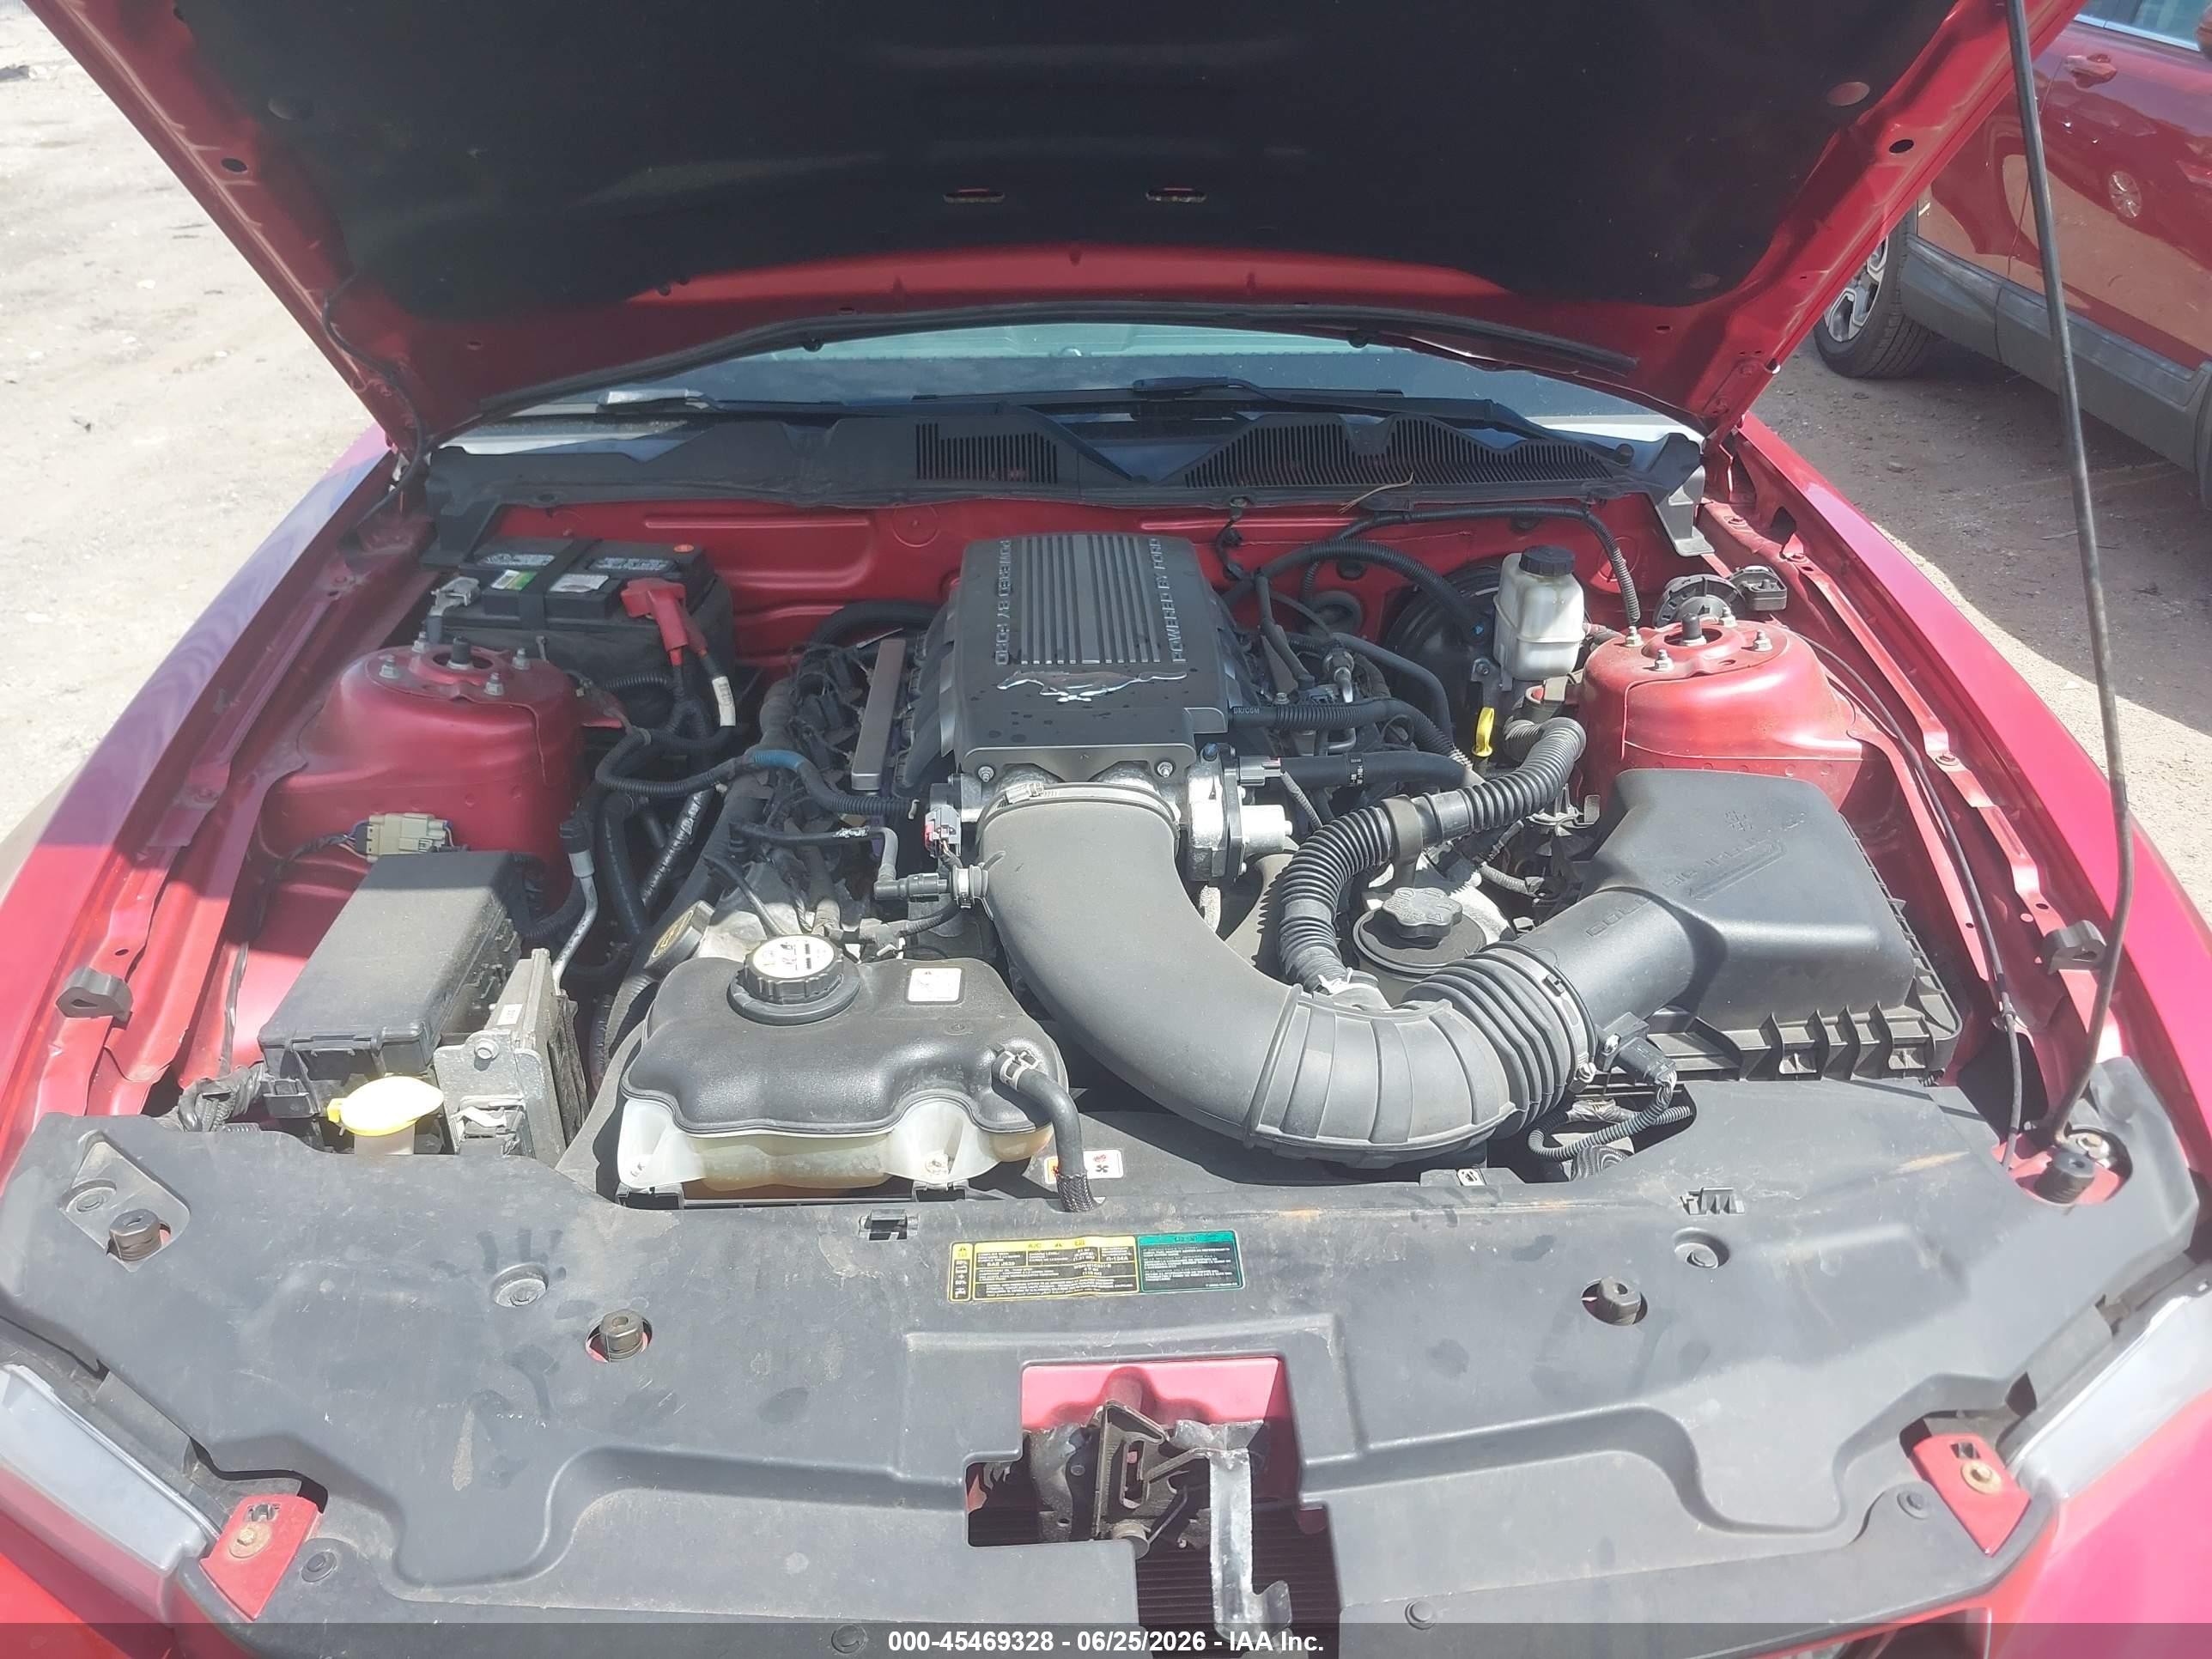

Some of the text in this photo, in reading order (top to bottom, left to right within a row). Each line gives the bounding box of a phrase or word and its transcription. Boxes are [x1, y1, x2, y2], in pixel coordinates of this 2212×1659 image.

[994, 541, 1012, 665] POWERED BY FORD
[1147, 538, 1188, 663] POWERED BY FORD
